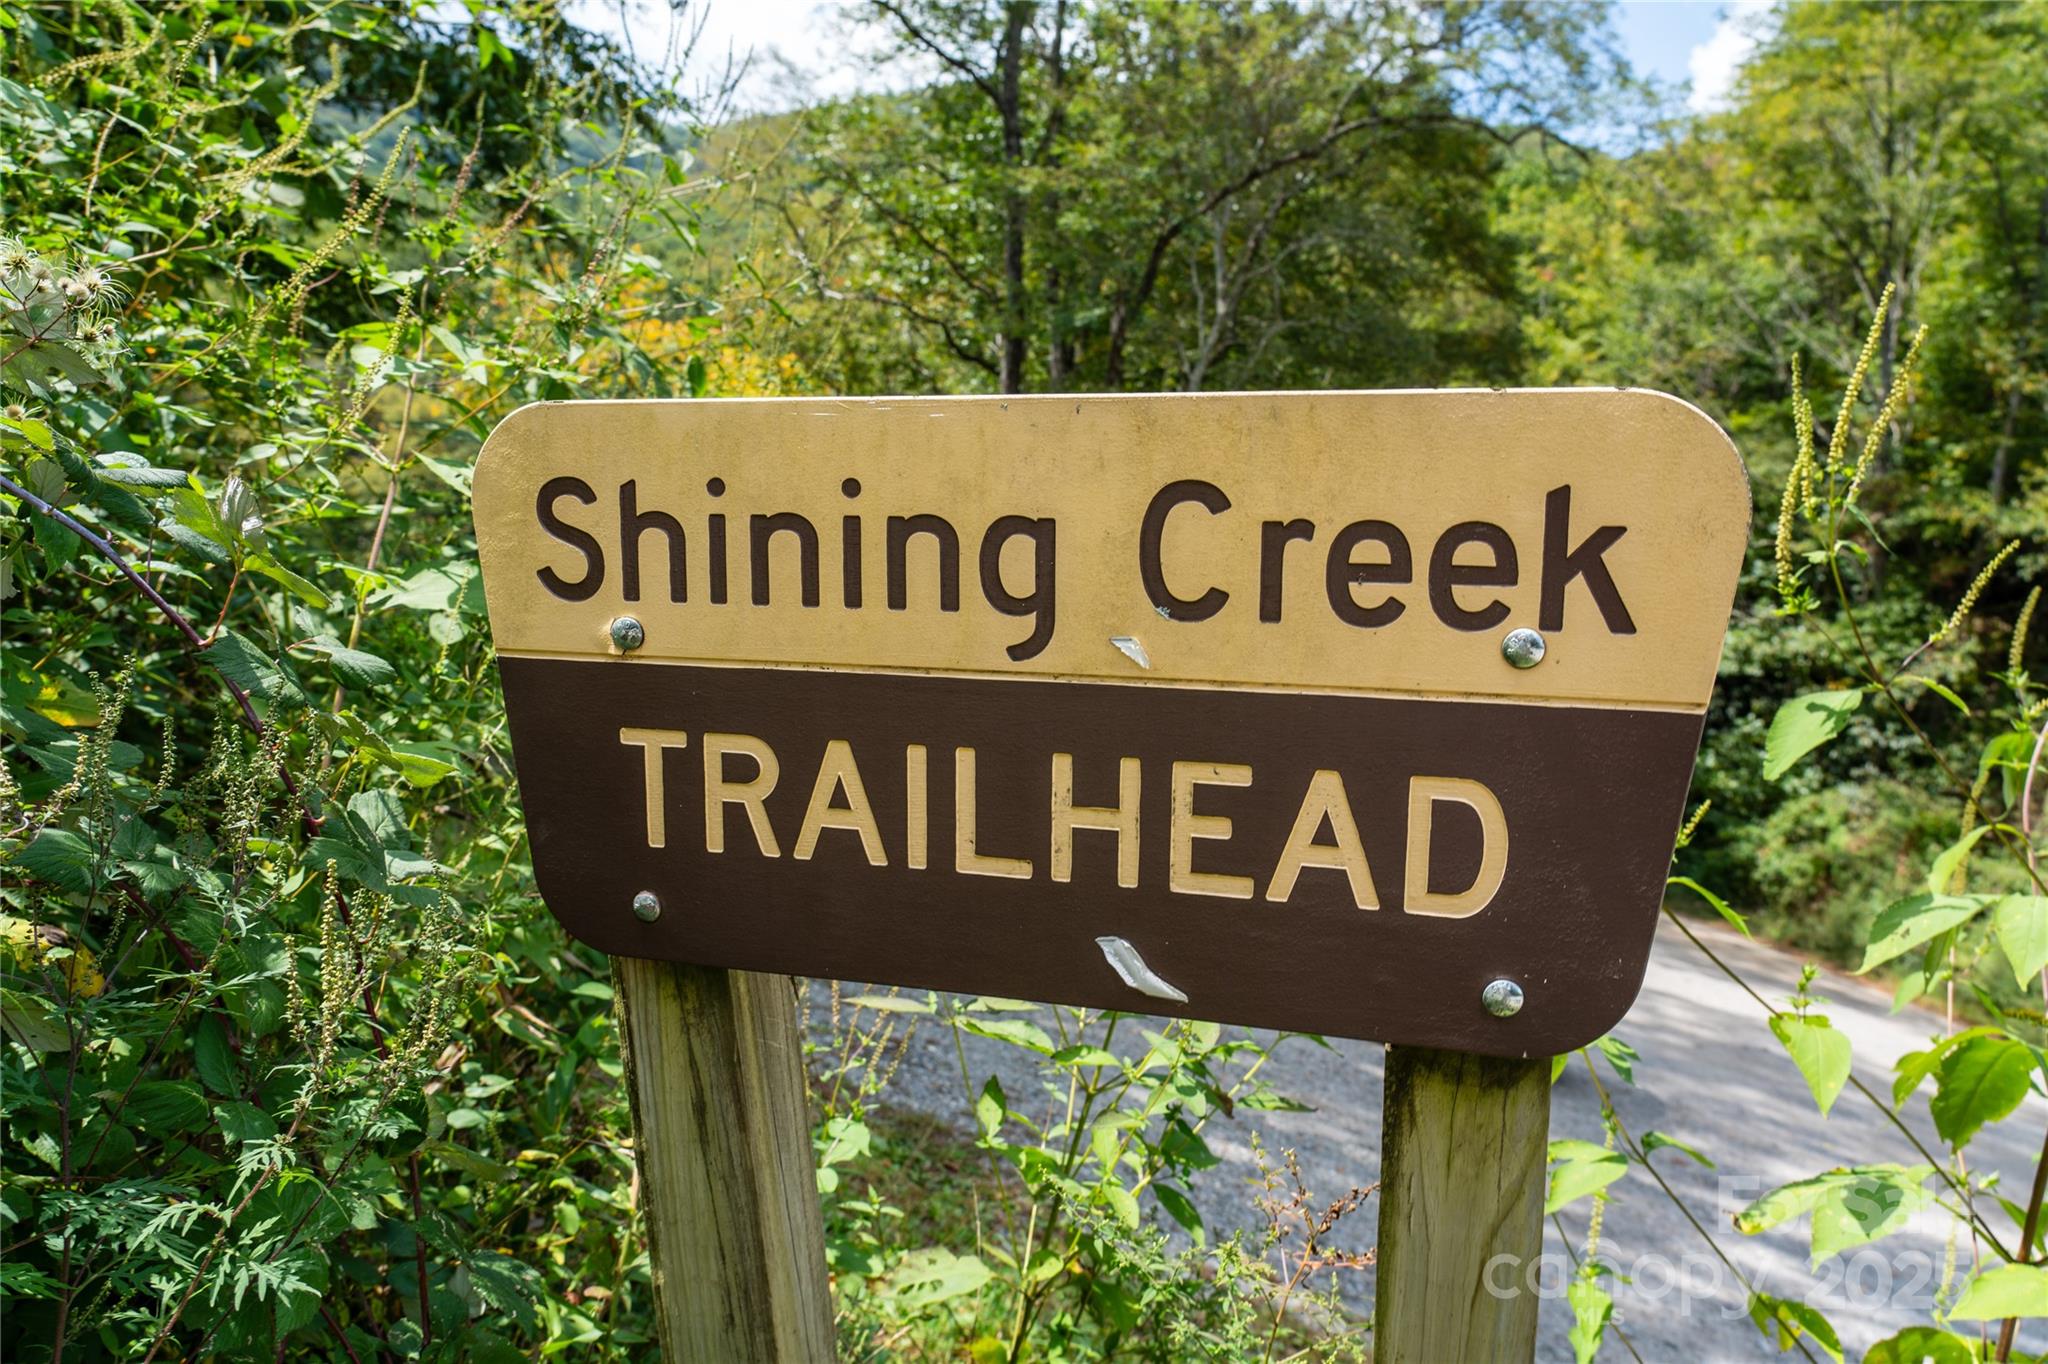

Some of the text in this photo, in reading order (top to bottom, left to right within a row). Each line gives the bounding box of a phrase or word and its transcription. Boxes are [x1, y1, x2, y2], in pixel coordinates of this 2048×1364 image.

[536, 476, 1637, 662] Shining Creek
[620, 727, 1509, 919] TRAILHEAD
